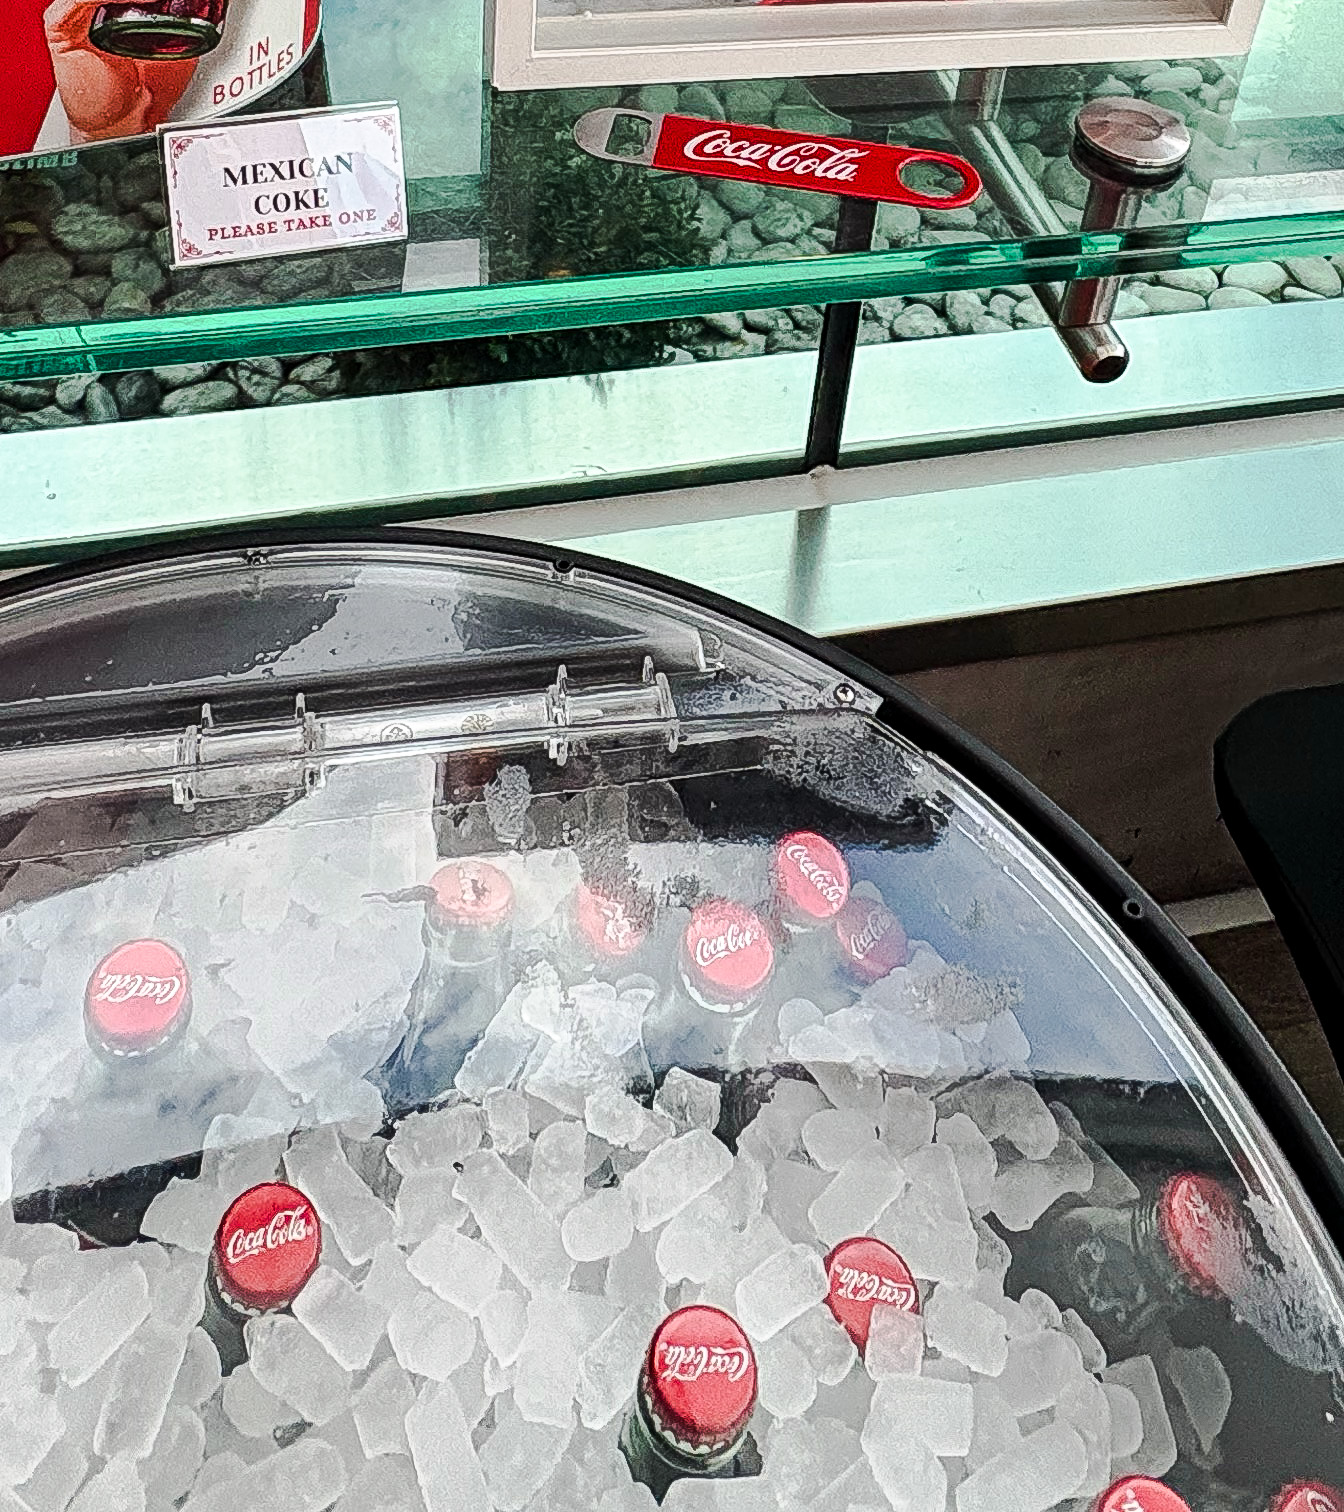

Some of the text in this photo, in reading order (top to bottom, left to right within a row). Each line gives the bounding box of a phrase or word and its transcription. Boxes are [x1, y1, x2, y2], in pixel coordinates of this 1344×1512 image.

[249, 36, 269, 66] IN
[213, 42, 295, 105] BOTTLES
[222, 152, 354, 188] MEXICAN
[684, 129, 869, 182] Coca-Cola
[254, 188, 330, 216] COKE
[208, 208, 378, 241] PLEASE TAKE ONE
[93, 974, 180, 1005] Coca-Cola
[227, 1205, 309, 1264] Coca-Cola
[661, 1344, 749, 1383] Coca-Cola
